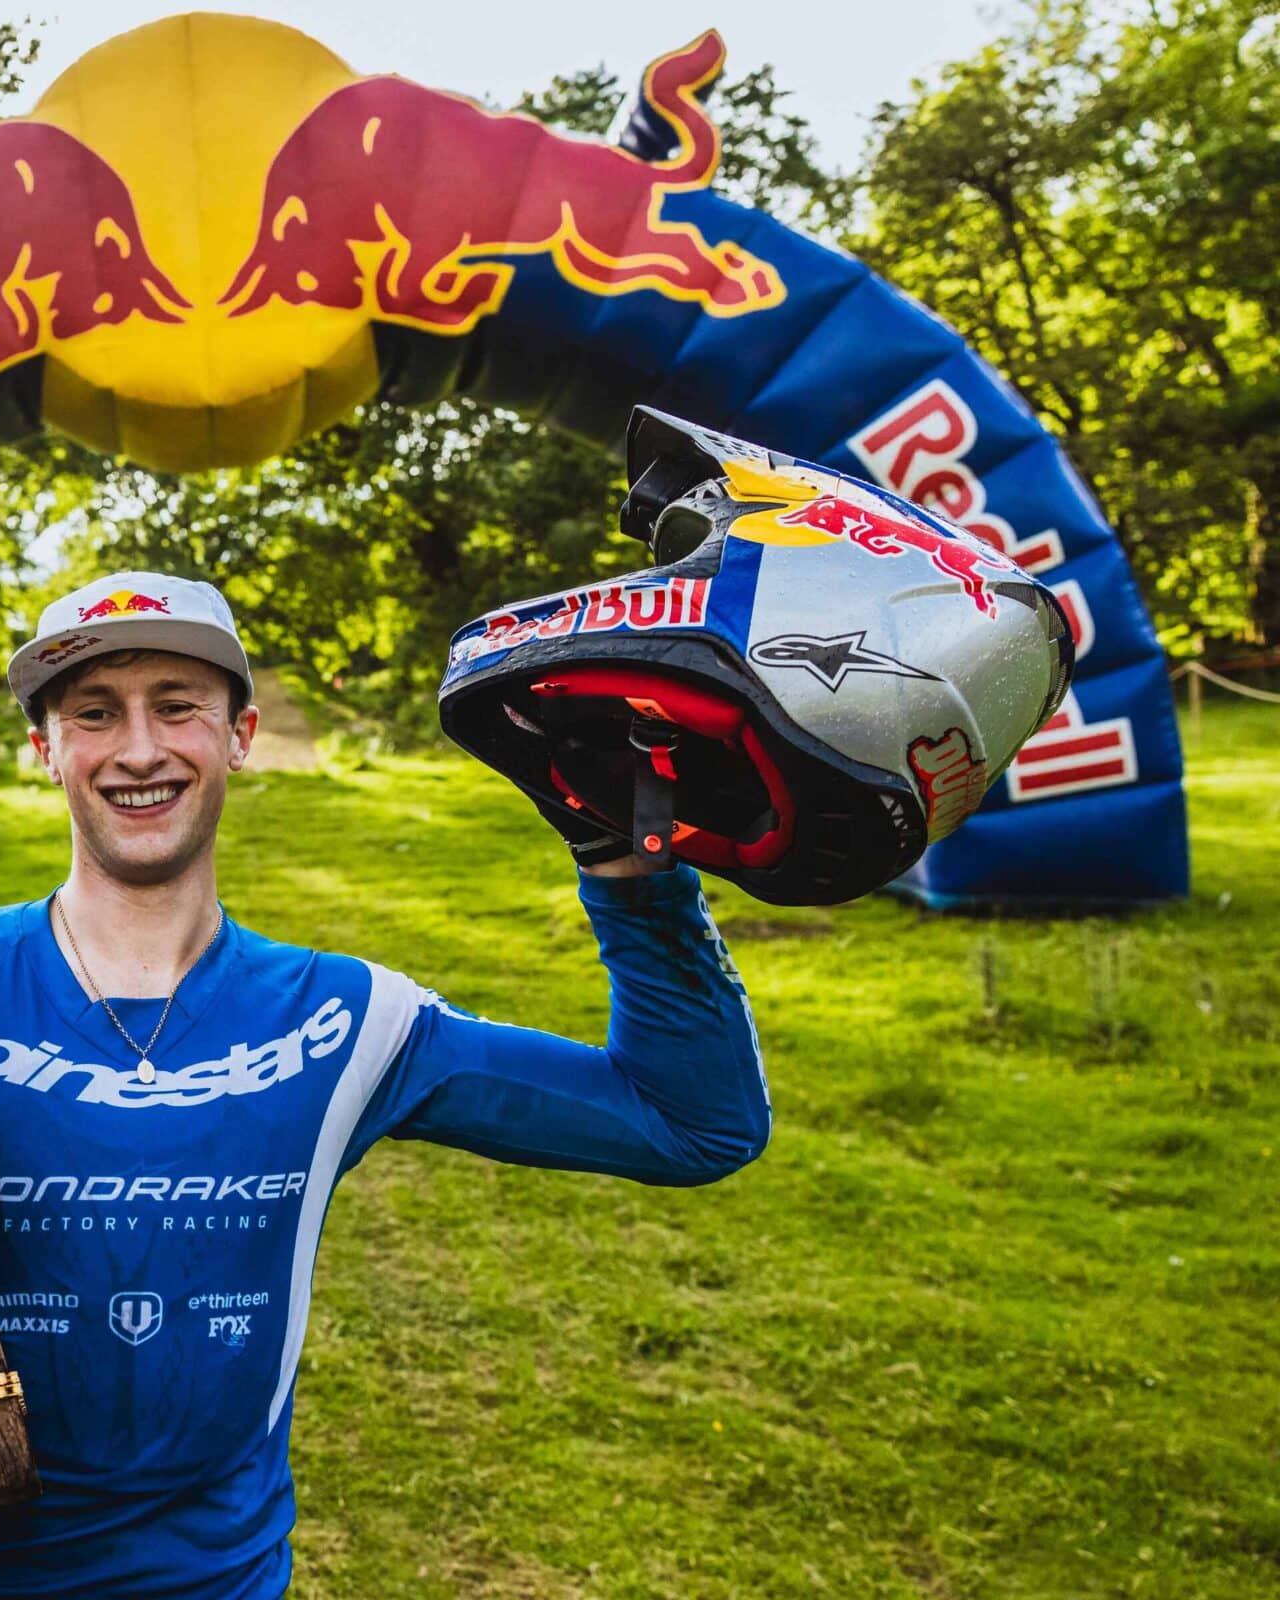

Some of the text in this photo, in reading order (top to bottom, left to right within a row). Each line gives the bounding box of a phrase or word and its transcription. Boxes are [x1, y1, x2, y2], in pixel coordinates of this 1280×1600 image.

[851, 383, 1060, 571] Red
[471, 577, 708, 657] Red Bull
[4, 1215, 268, 1232] FACTORY RACING
[208, 1315, 251, 1338] FOX
